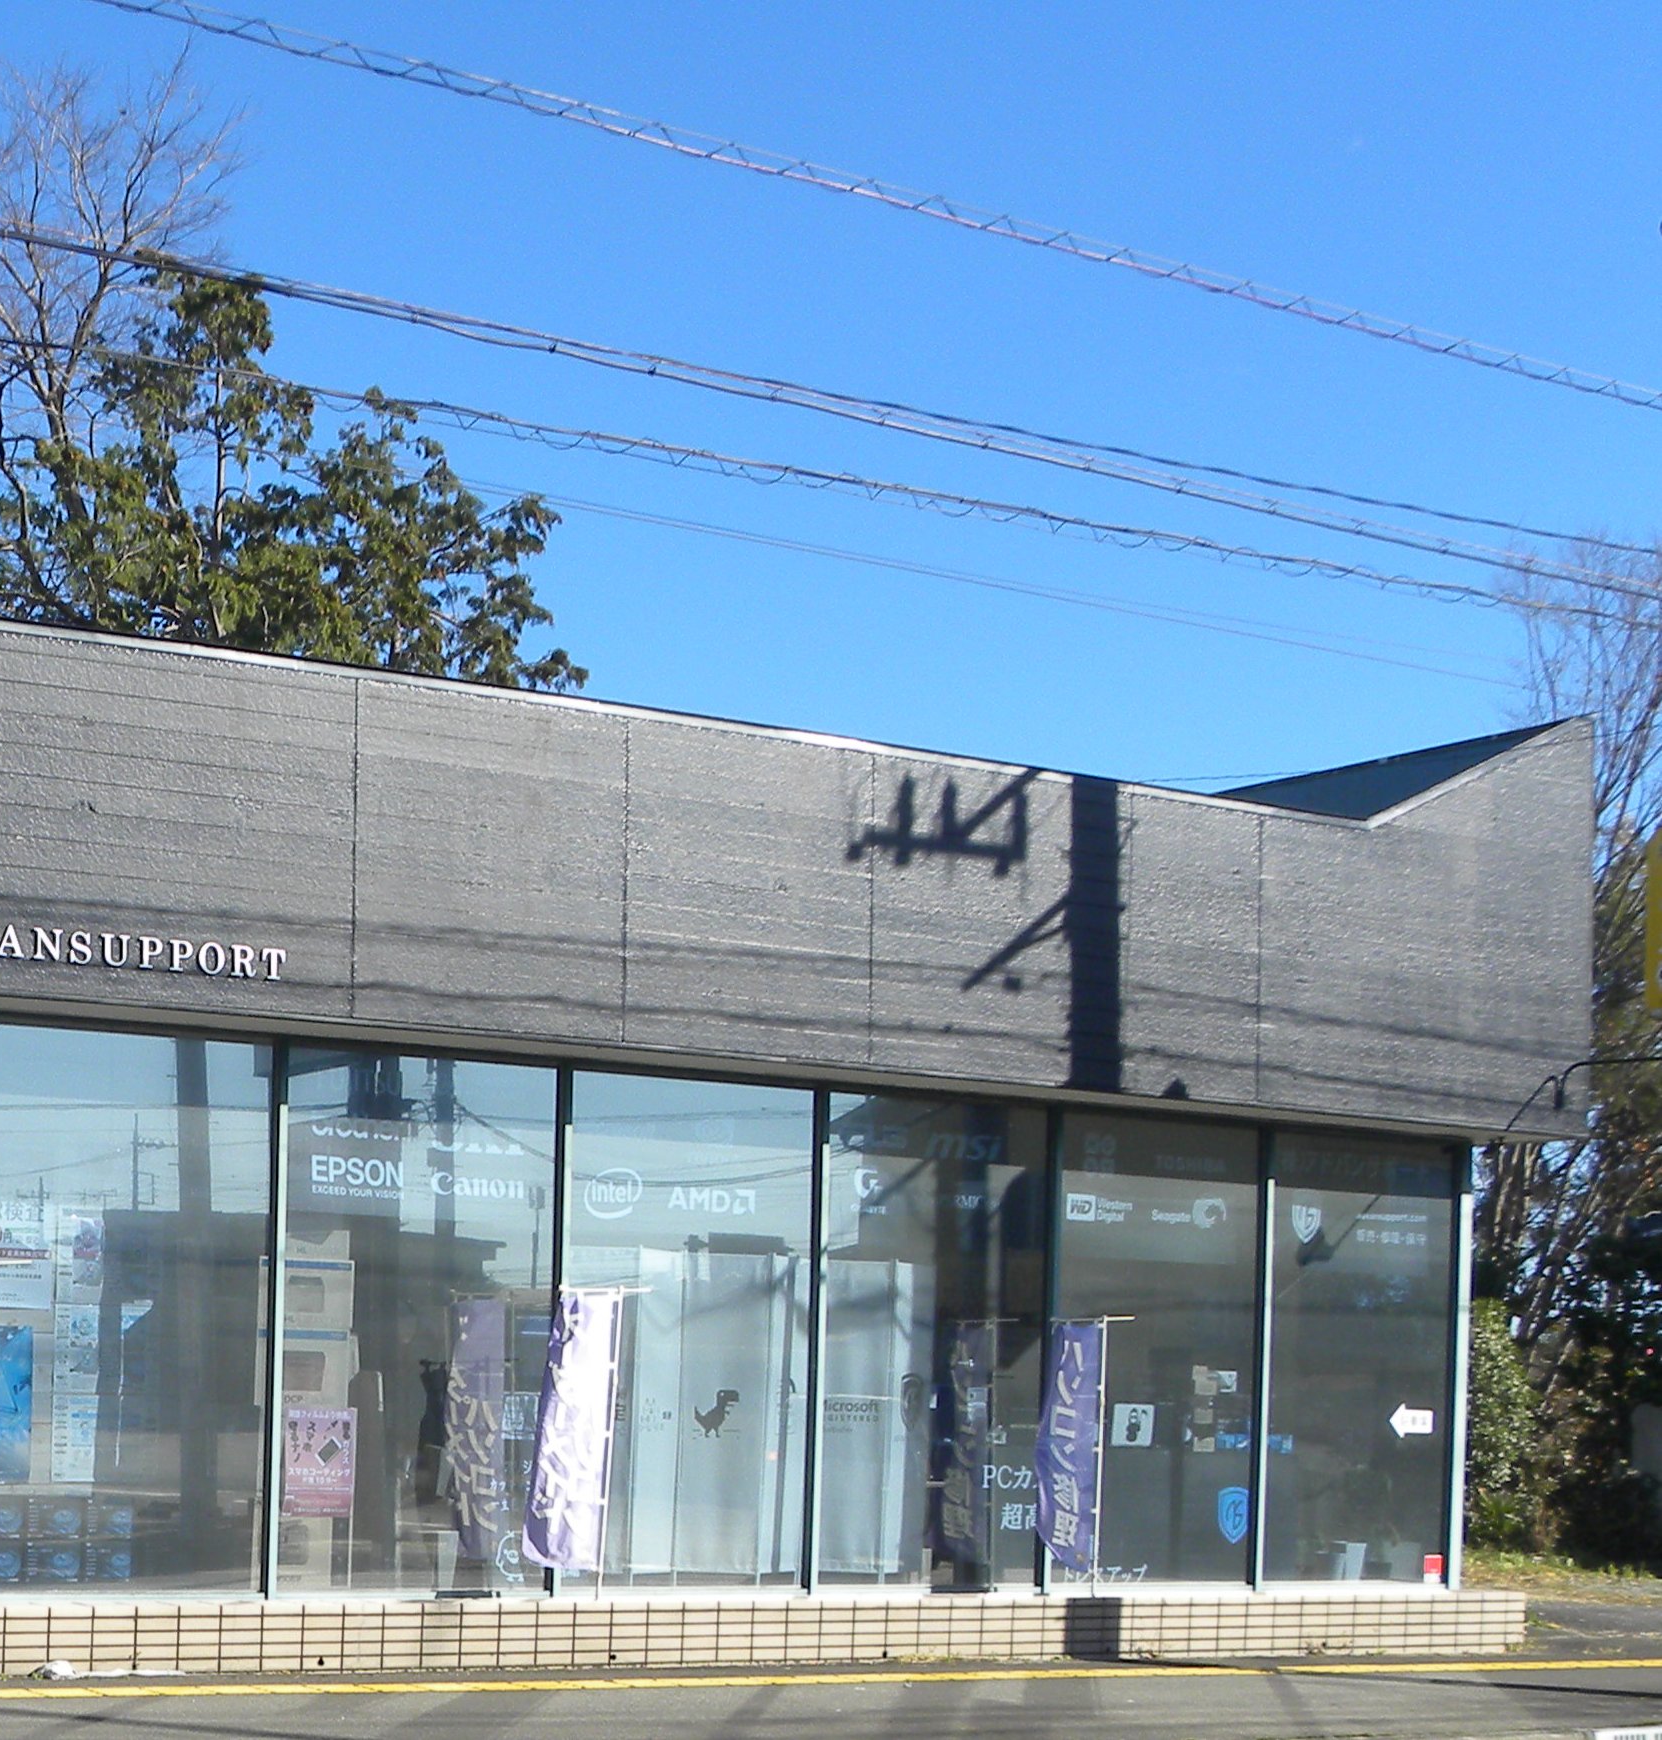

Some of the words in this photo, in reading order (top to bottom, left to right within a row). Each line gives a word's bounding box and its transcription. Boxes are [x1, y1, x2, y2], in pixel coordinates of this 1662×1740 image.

[311, 1154, 404, 1188] EPSON
[312, 1185, 346, 1196] EXCEED
[348, 1187, 373, 1198] YOUR
[430, 1171, 525, 1199] Canon
[591, 1179, 632, 1203] intel
[667, 1187, 731, 1213] AMD
[1152, 1208, 1191, 1224] Seagate
[981, 1464, 1037, 1490] PCカ
[1000, 1502, 1037, 1531] 超高
